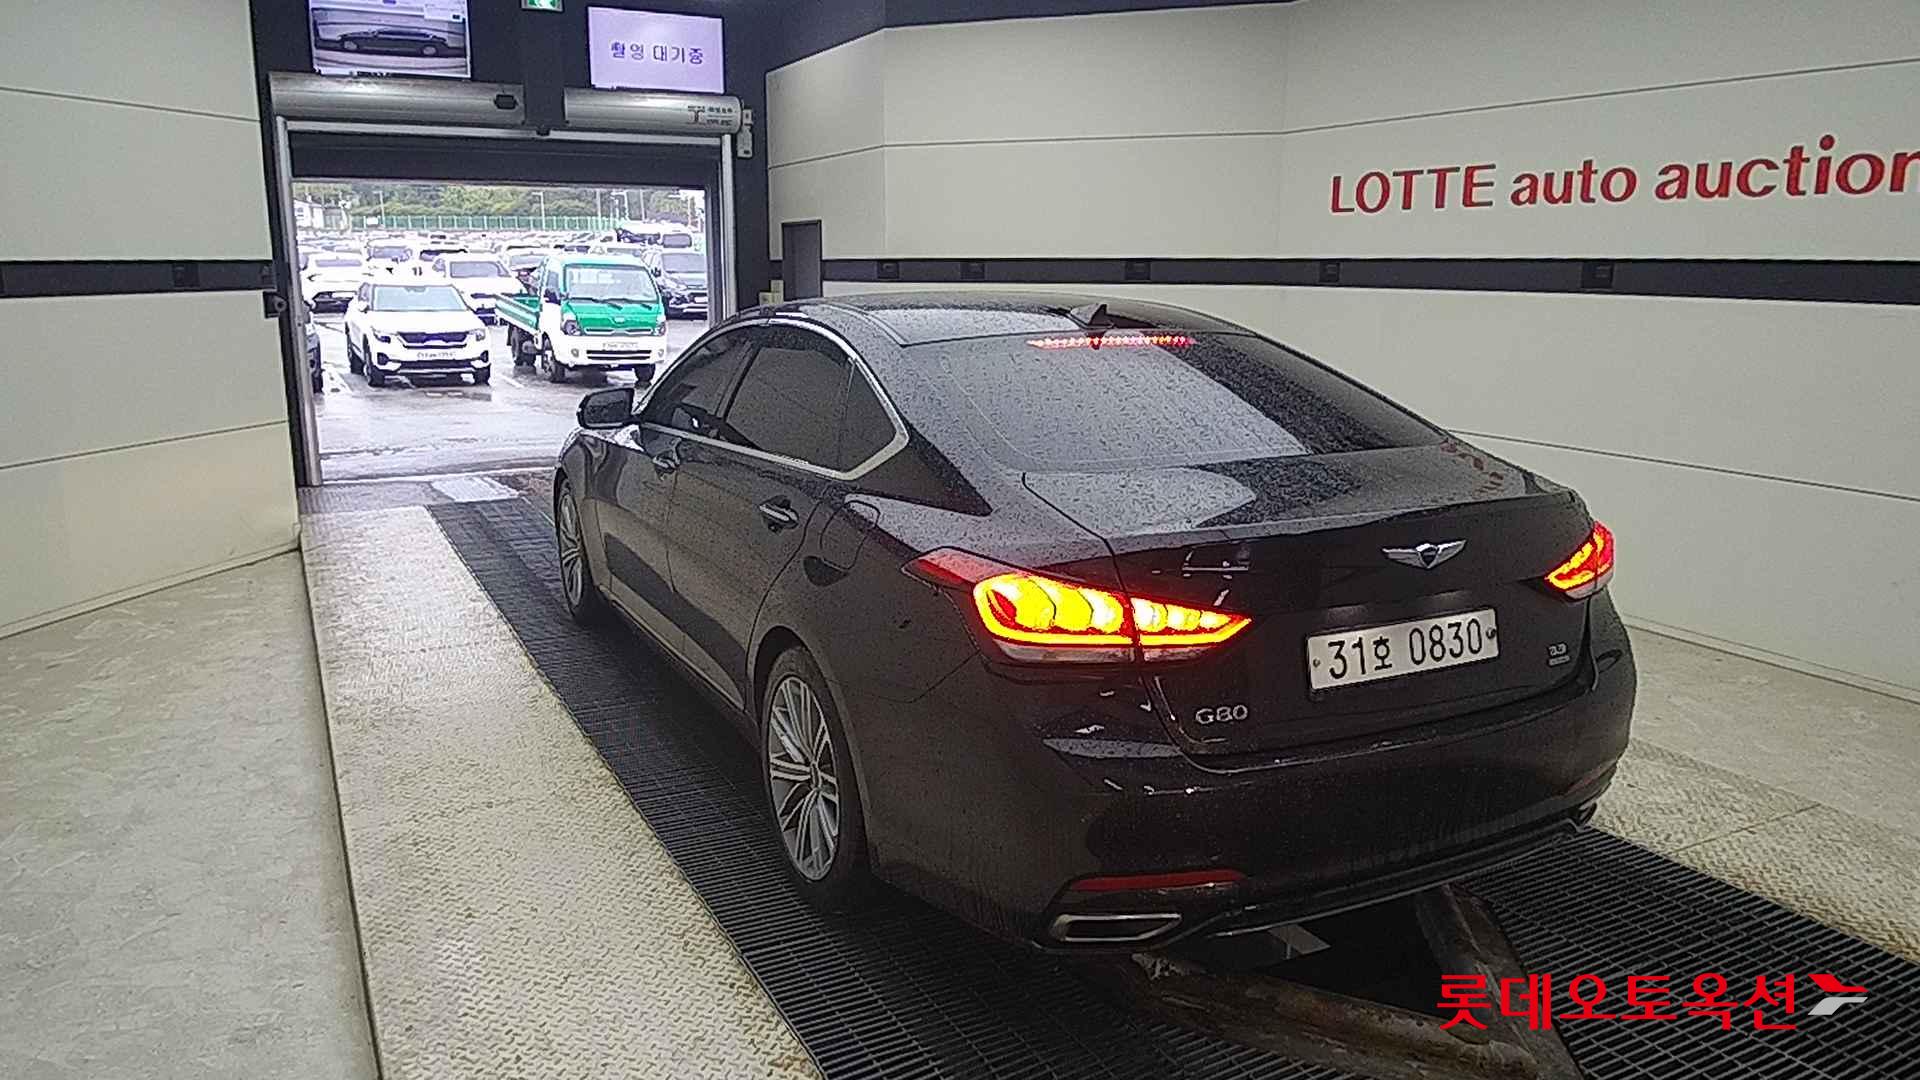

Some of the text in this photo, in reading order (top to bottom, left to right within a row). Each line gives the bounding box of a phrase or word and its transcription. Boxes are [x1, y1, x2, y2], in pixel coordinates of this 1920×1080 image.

[653, 44, 704, 65] 대기중
[1330, 163, 1496, 214] LOTTE
[1510, 159, 1638, 207] auto
[1327, 617, 1483, 680] 31호 0830
[1195, 704, 1248, 725] G80
